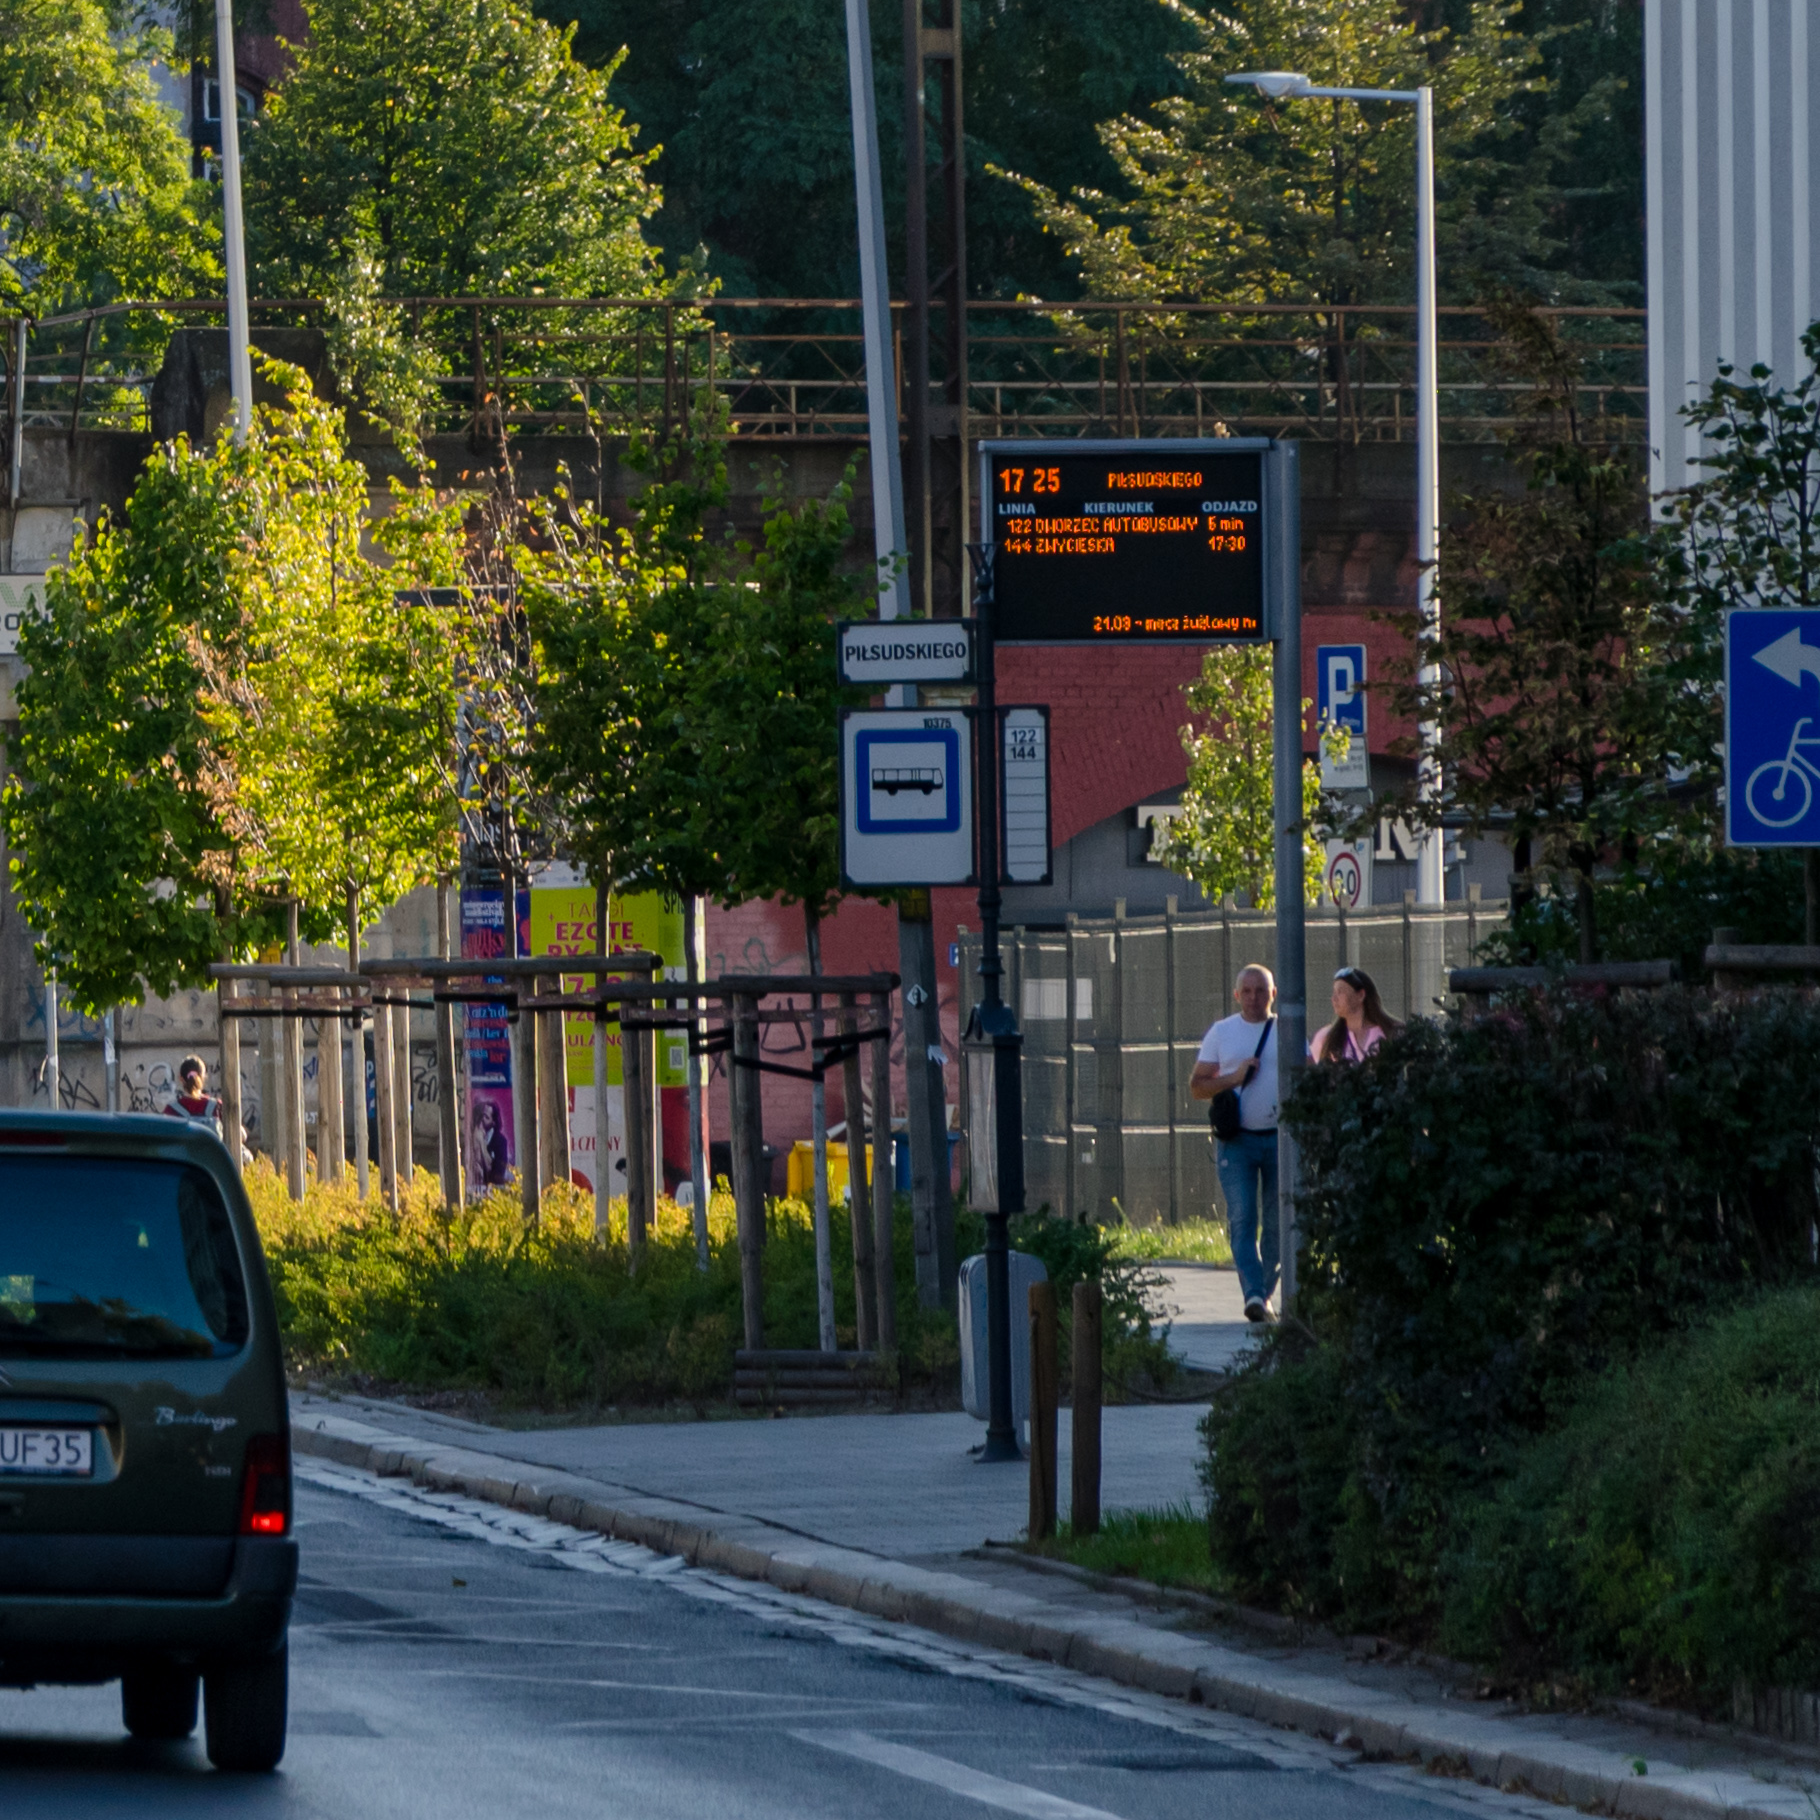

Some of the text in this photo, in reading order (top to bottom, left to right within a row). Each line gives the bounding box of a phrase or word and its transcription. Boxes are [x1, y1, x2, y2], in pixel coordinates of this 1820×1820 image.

[999, 467, 1060, 493] 17 25
[998, 502, 1036, 515] LINIA
[1084, 502, 1154, 514] KIERUNEK
[1201, 501, 1258, 513] ODJAZD
[1007, 518, 1032, 534] 122
[1035, 517, 1100, 534] DWORZEC
[1103, 516, 1198, 533] AUTOBUSOWY
[1220, 517, 1244, 531] min
[1004, 538, 1032, 553] 144
[845, 642, 967, 661] PIŁSUDSKIEGO
[923, 718, 952, 729] 10375
[1011, 730, 1037, 743] 122
[1010, 746, 1036, 759] 144
